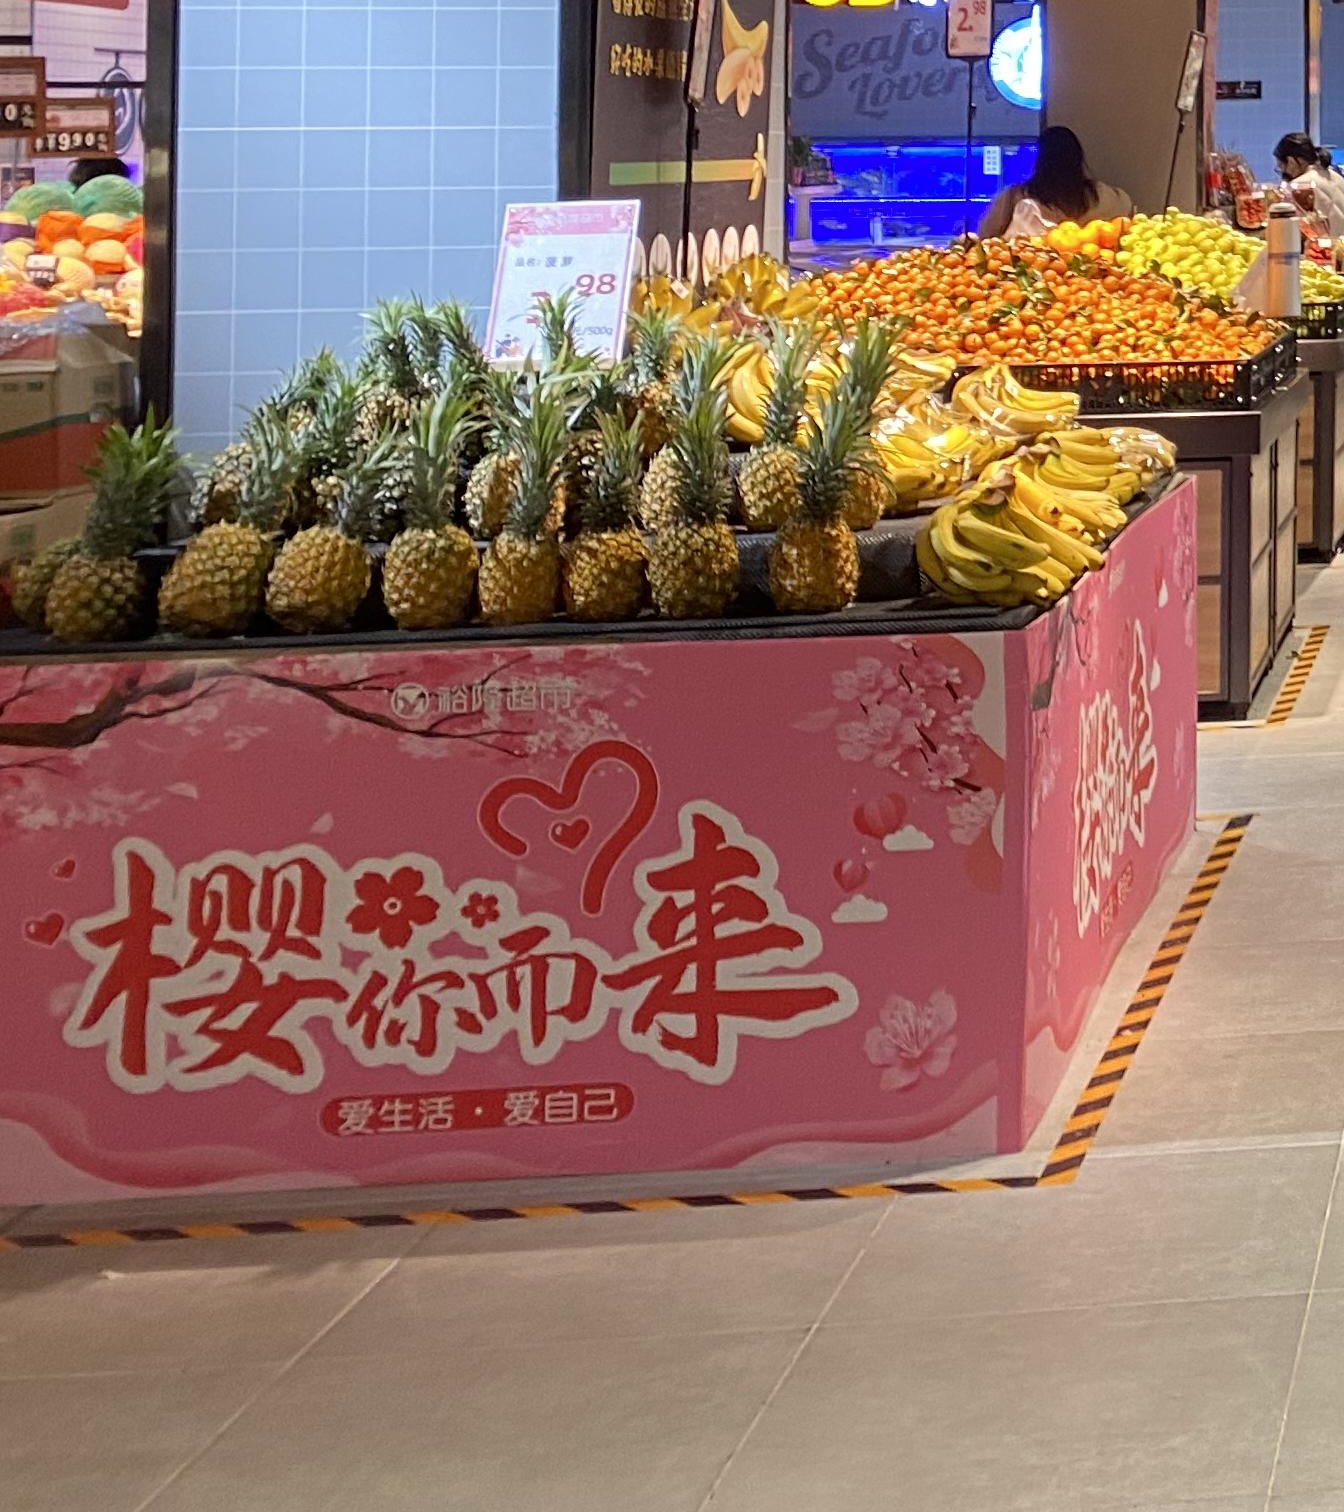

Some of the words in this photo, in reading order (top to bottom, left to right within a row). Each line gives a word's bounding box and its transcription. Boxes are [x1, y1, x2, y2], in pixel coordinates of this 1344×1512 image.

[575, 273, 616, 297] 98
[74, 810, 844, 1081] 樱你而来
